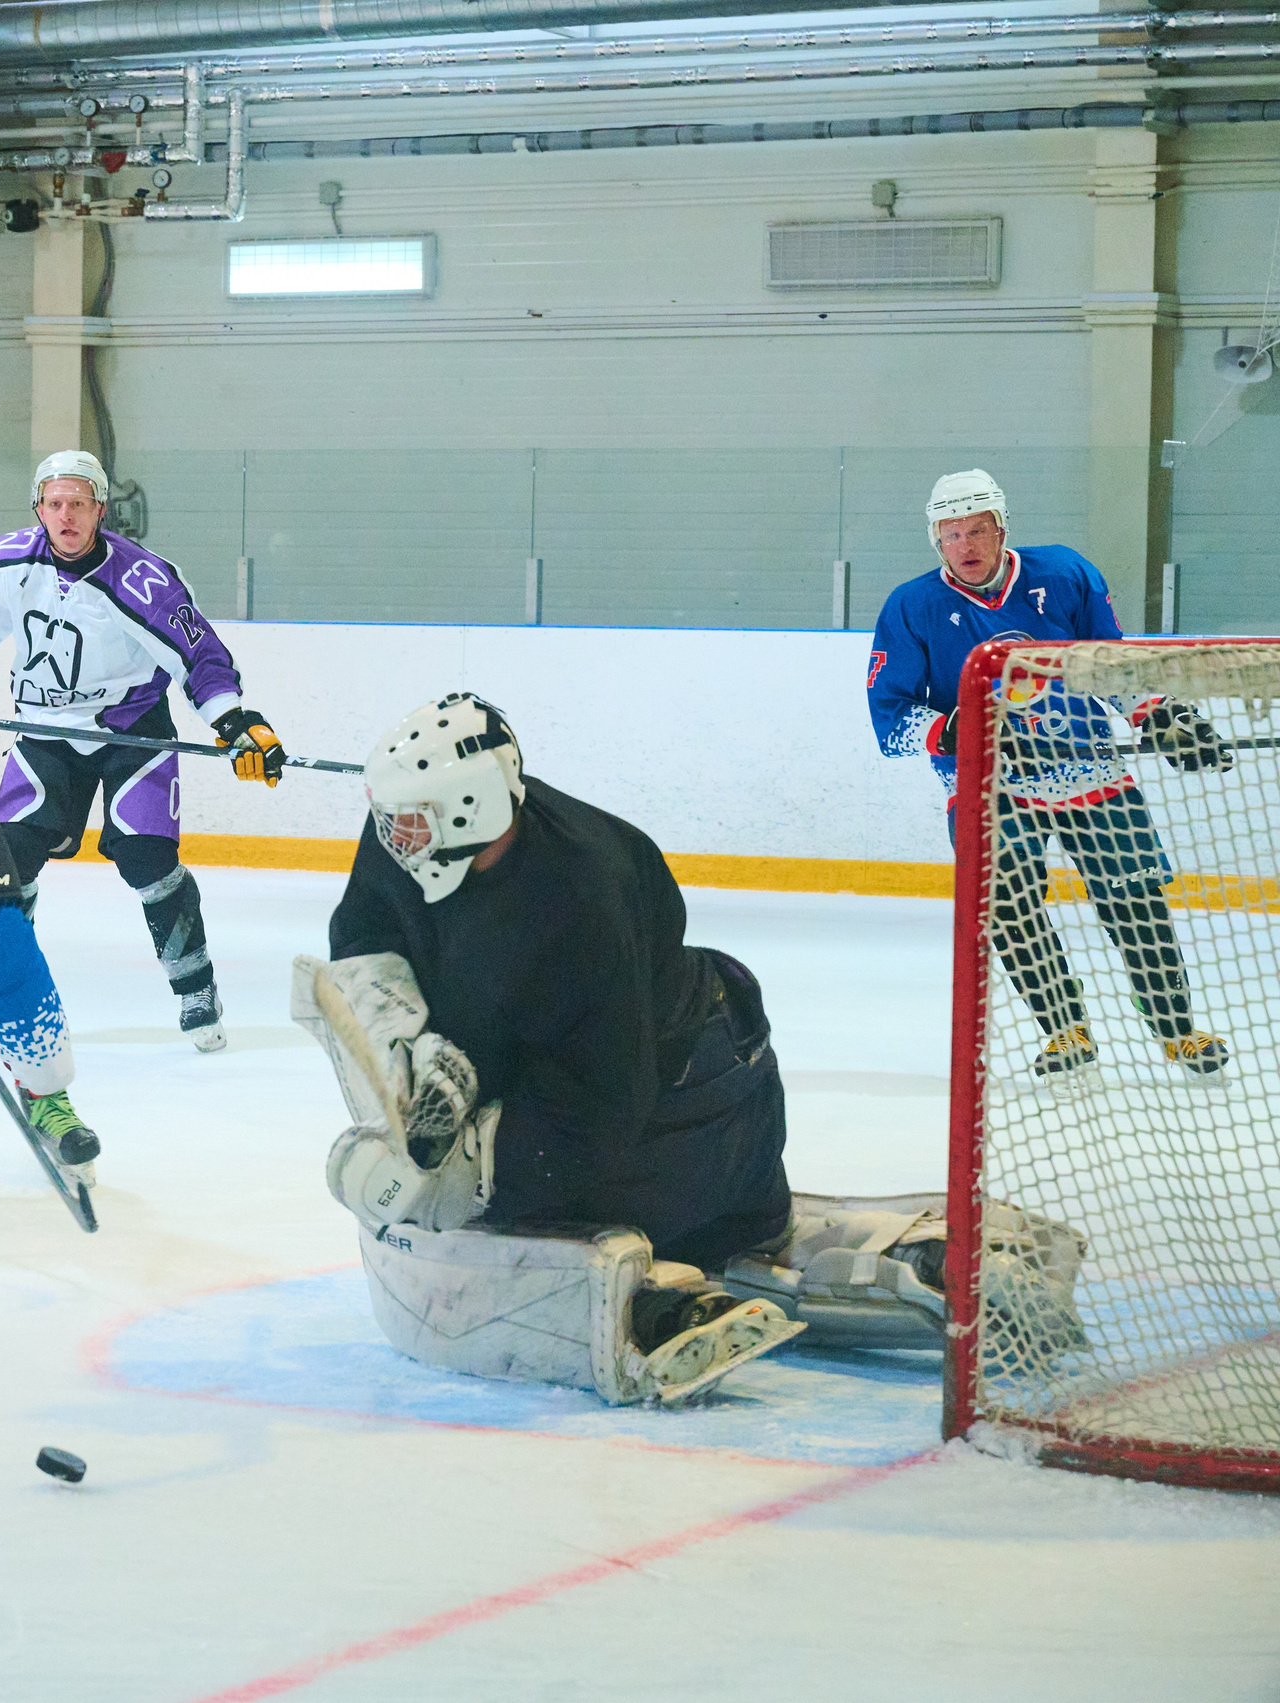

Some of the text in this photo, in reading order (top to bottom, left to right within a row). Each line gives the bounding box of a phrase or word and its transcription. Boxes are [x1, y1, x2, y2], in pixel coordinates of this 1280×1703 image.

[1028, 587, 1047, 614] 7
[168, 604, 205, 648] 22
[867, 651, 887, 688] 7
[377, 1179, 402, 1207] P29
